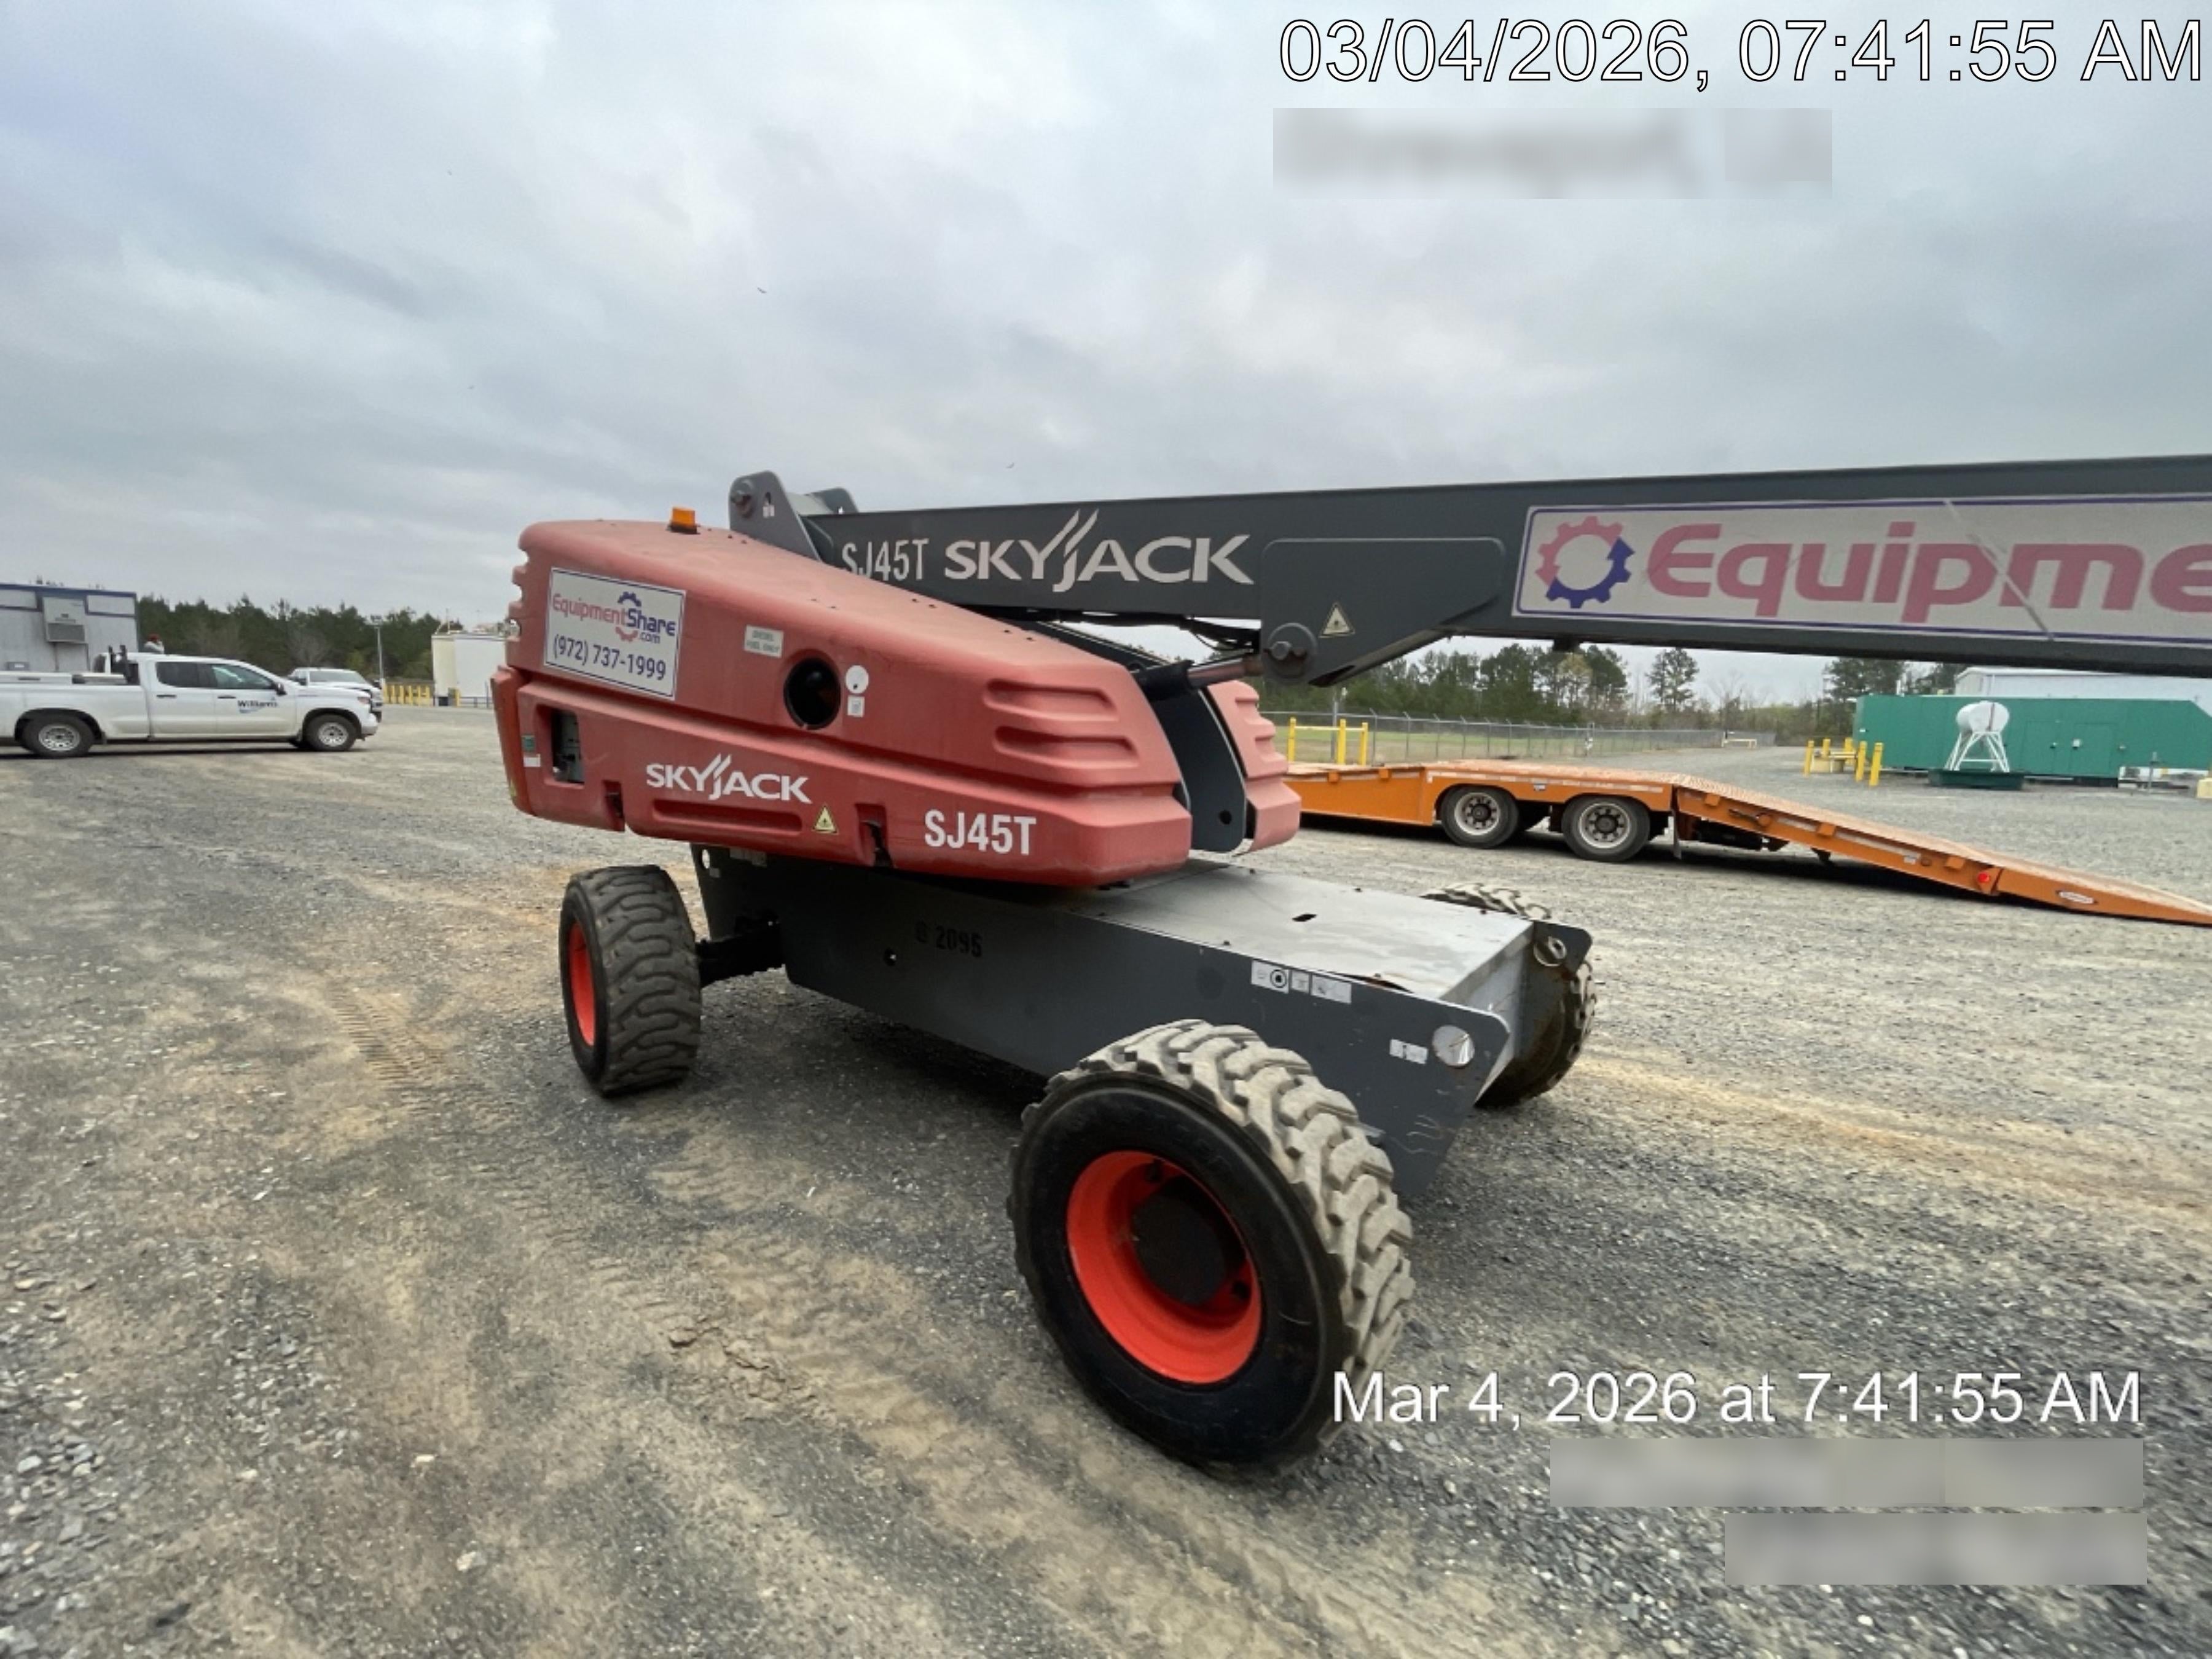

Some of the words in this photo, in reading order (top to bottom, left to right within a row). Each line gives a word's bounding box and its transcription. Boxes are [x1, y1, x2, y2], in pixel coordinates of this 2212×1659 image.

[842, 538, 930, 581] SJ45T
[944, 509, 1254, 592] SKYJACK
[553, 593, 676, 637] EquipmentShare
[554, 634, 589, 665] (972)
[593, 645, 666, 680] 737-1999
[646, 753, 813, 804] SKYJACK
[925, 809, 1037, 856] SJ45T
[934, 925, 982, 957] 2095
